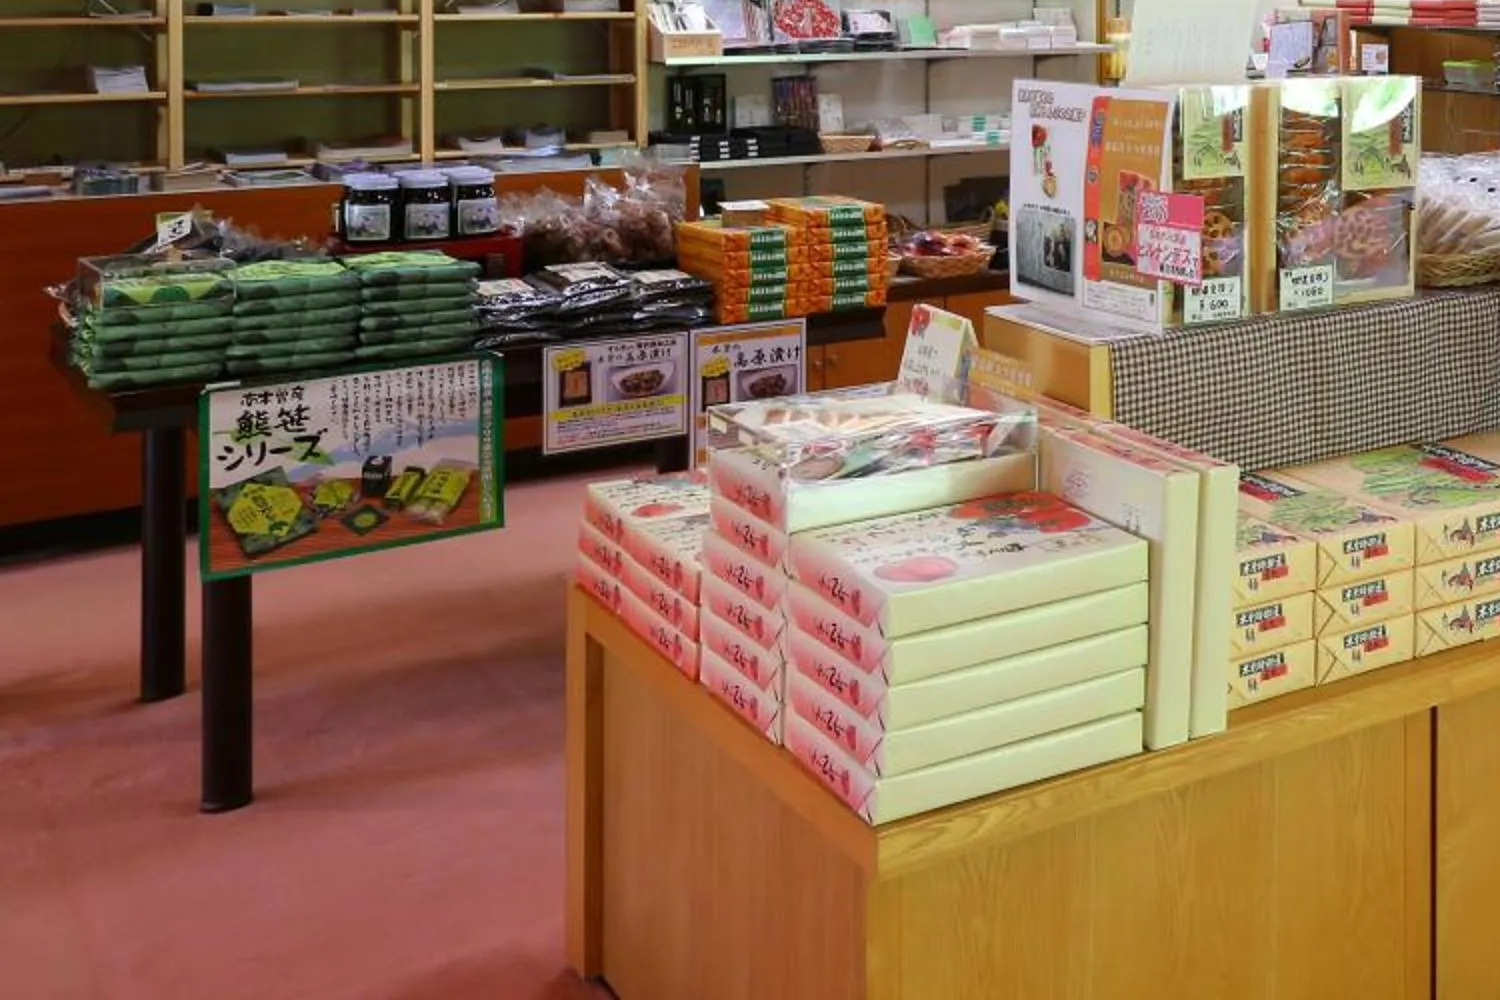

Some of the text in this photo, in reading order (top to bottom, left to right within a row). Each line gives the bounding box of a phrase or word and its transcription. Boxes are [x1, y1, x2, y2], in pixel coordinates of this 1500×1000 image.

[236, 404, 311, 442] 熊笹
[217, 428, 328, 472] シリーズ
